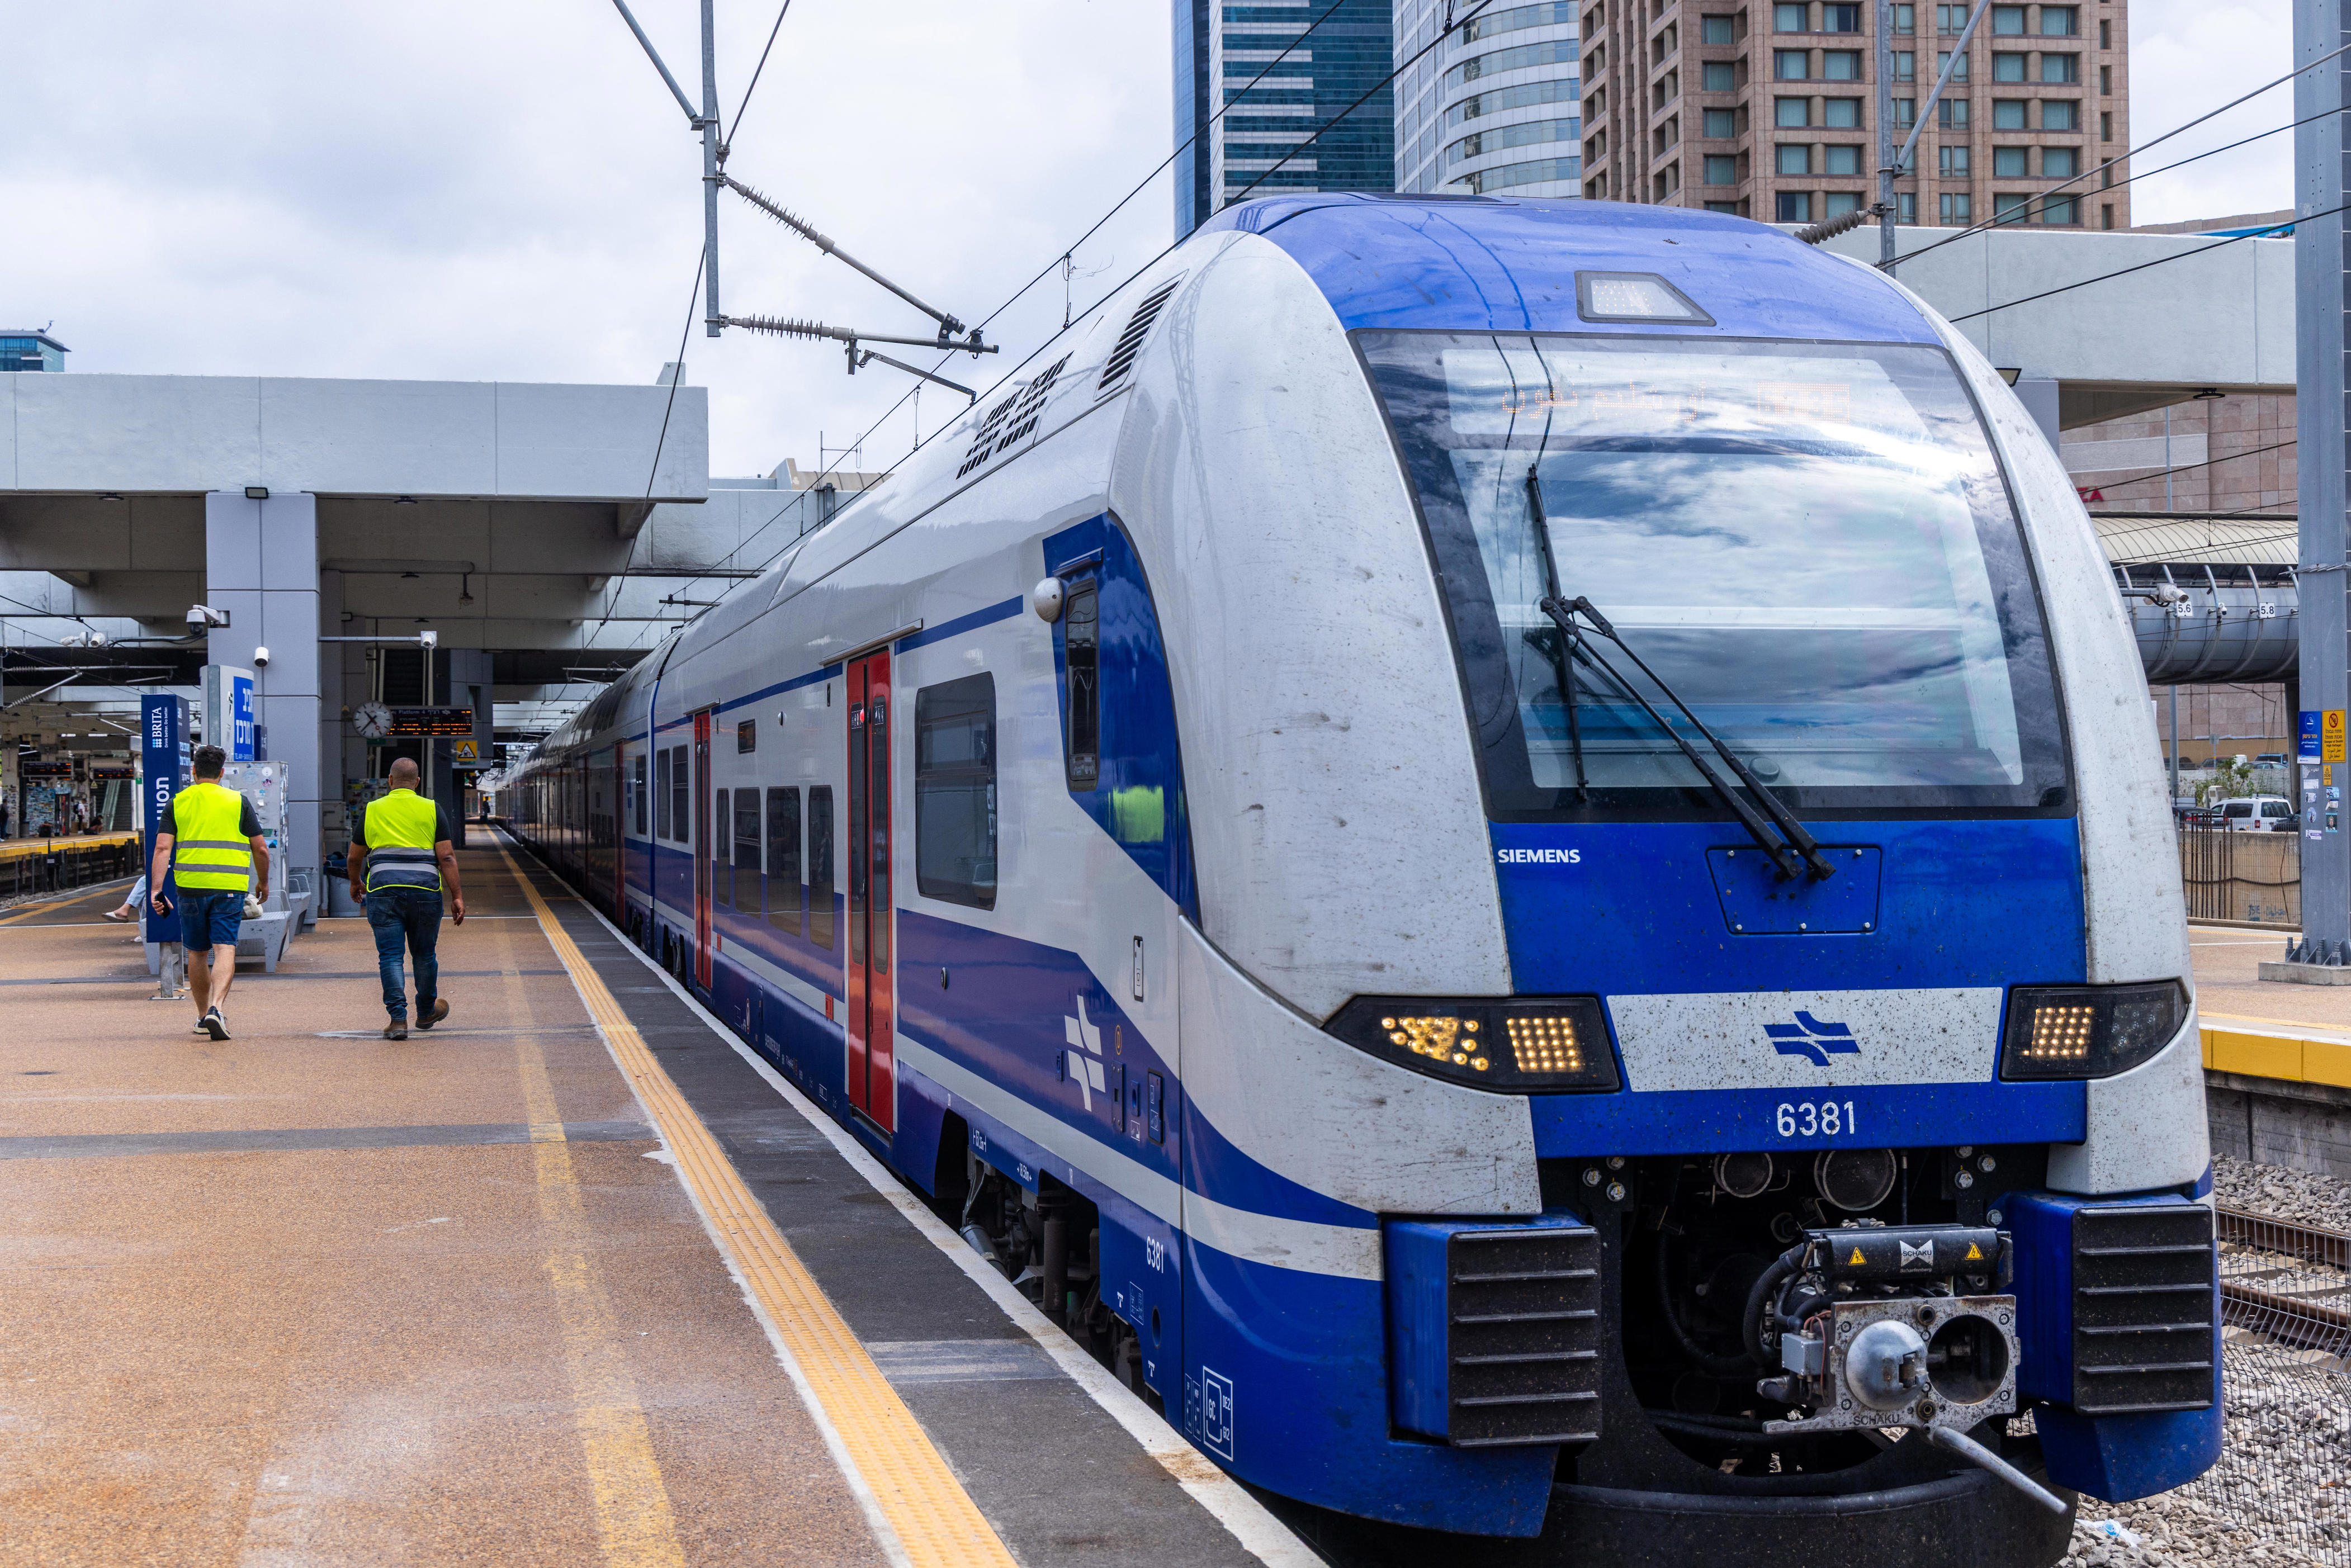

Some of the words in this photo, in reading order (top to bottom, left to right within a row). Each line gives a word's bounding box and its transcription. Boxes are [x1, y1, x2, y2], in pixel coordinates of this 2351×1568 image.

[2178, 604, 2191, 613] 5.6
[2260, 605, 2274, 615] 5.8
[152, 707, 162, 737] BRITA
[1497, 849, 1581, 863] SIEMENS
[1777, 1101, 1855, 1137] 6381
[1147, 1236, 1163, 1273] 6381
[1208, 1399, 1216, 1421] GC
[1222, 1395, 1231, 1410] DE2
[1853, 1413, 1899, 1425] SCHAKU
